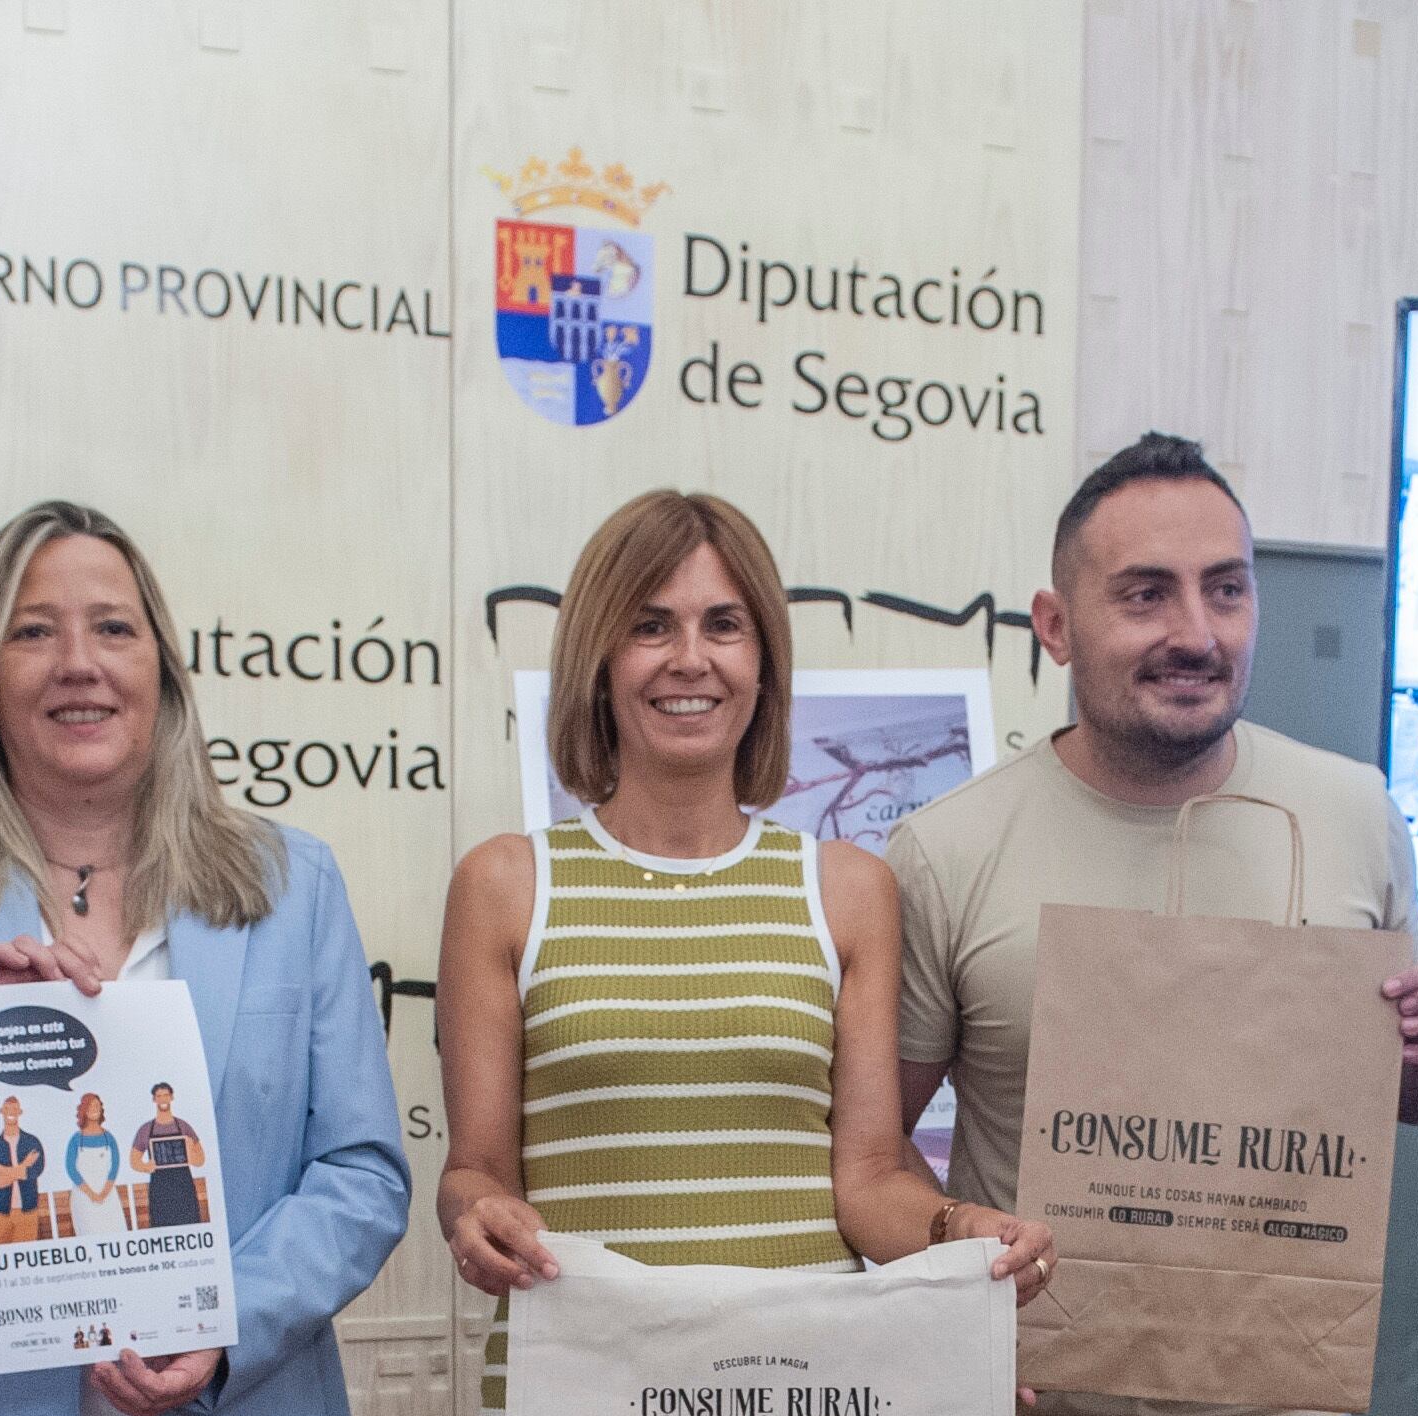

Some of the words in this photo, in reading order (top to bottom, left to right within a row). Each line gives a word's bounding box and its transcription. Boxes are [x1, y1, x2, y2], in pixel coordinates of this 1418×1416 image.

[121, 262, 452, 339] PROVINCIAL
[683, 234, 1044, 335] Diputación
[680, 341, 763, 408] de
[793, 351, 1044, 441] Segovia
[207, 728, 445, 807] egovia
[26, 1057, 73, 1071] Comercio
[1051, 1109, 1222, 1166] CONSUME
[1237, 1125, 1355, 1179] RURAL
[1088, 1181, 1136, 1198] AUNQUE
[1140, 1186, 1161, 1200] LAS
[1165, 1189, 1203, 1204] COSAS
[1044, 1203, 1104, 1220] CONSUMIR
[1112, 1208, 1127, 1221] LO
[1131, 1210, 1170, 1226] RURAL
[1177, 1215, 1226, 1232] SIEMPRE
[1267, 1222, 1297, 1237] ALGO
[14, 1245, 93, 1269] PUEBLO,
[97, 1242, 121, 1260] TU
[127, 1232, 214, 1256] COMERCIO
[20, 1276, 31, 1286] 30
[33, 1275, 44, 1285] de
[47, 1269, 97, 1285] septiembre
[98, 1268, 118, 1278] tres
[119, 1265, 146, 1275] bonos
[148, 1263, 160, 1272] de
[161, 1260, 177, 1270] 10€
[50, 1297, 118, 1320] COMERCIO
[713, 1355, 761, 1371] DESCUBRE
[766, 1355, 777, 1366] LA
[780, 1357, 809, 1371] MAGIA
